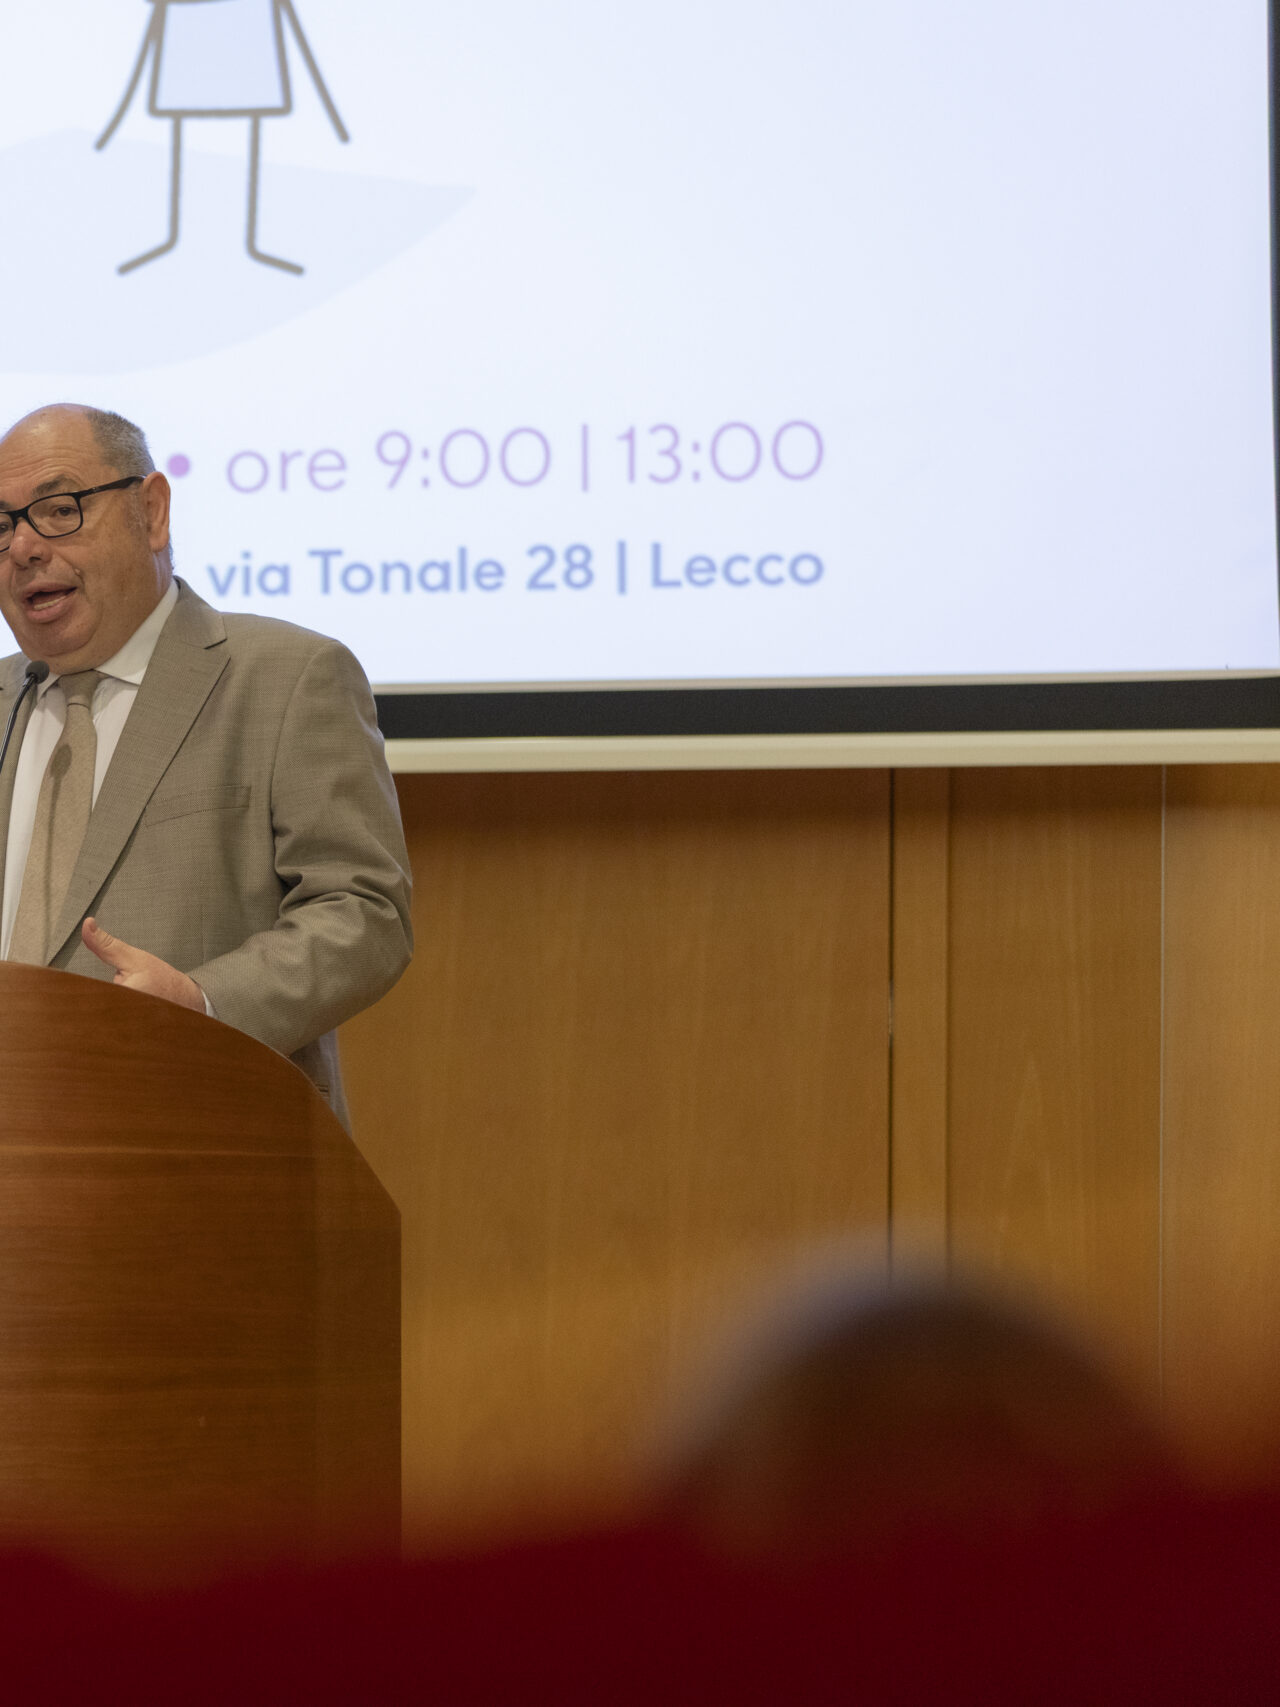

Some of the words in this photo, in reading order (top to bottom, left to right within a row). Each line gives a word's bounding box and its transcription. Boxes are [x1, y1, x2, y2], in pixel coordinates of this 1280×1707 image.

[225, 449, 348, 494] ore
[375, 426, 552, 490] 9:00
[617, 419, 825, 485] 13:00
[206, 550, 291, 599] via
[307, 546, 506, 597] Tonale
[526, 542, 595, 593] 28
[651, 541, 825, 590] Lecco
